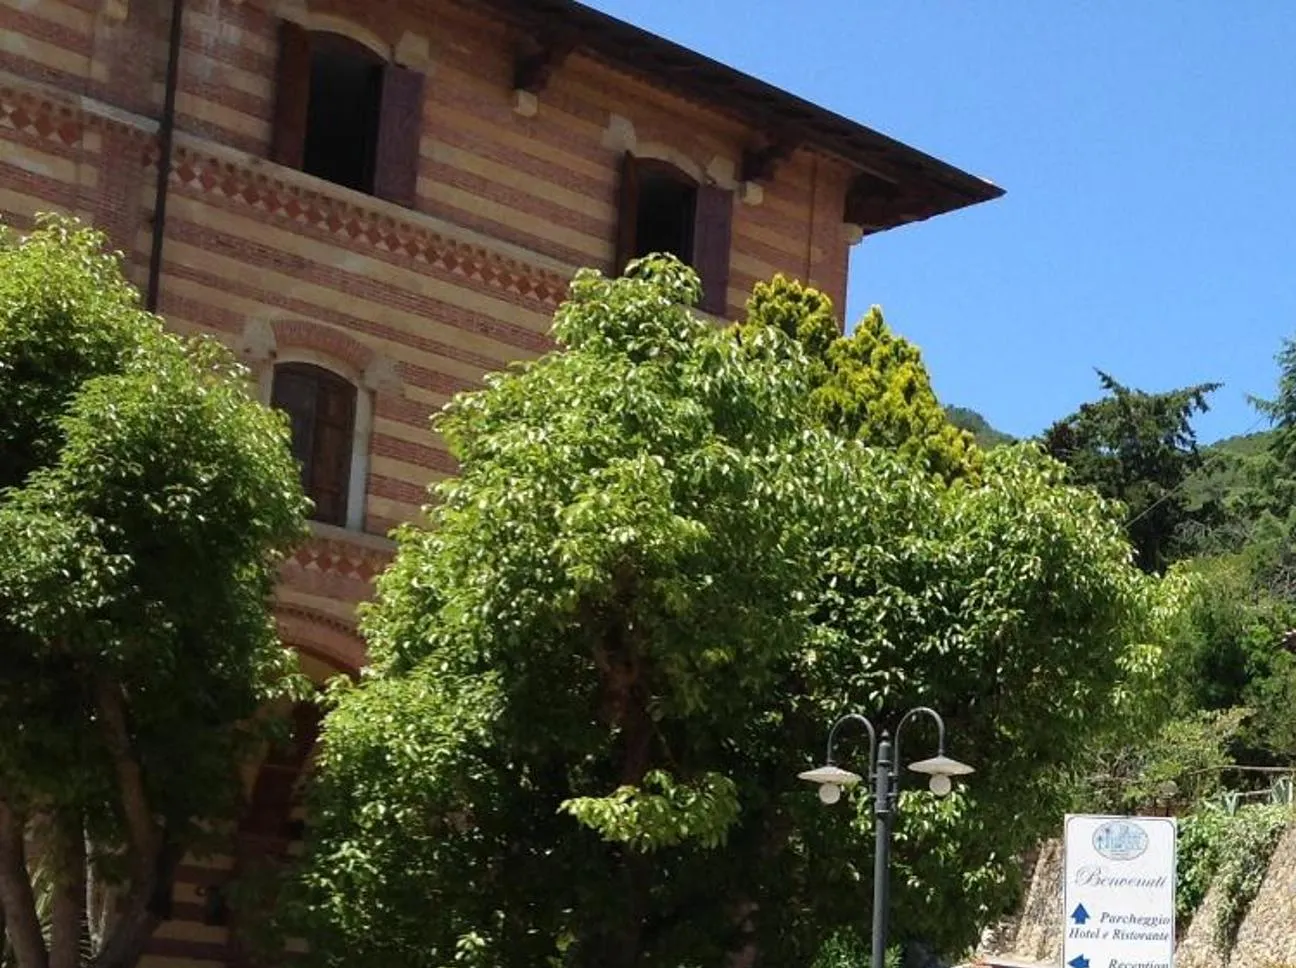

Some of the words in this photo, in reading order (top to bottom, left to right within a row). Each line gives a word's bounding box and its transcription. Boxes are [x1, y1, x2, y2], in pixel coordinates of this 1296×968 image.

[1076, 864, 1167, 888] Benvenuti
[1100, 912, 1171, 927] Parcheggio
[1069, 928, 1100, 940] Hotel
[1112, 929, 1169, 942] Ristorante
